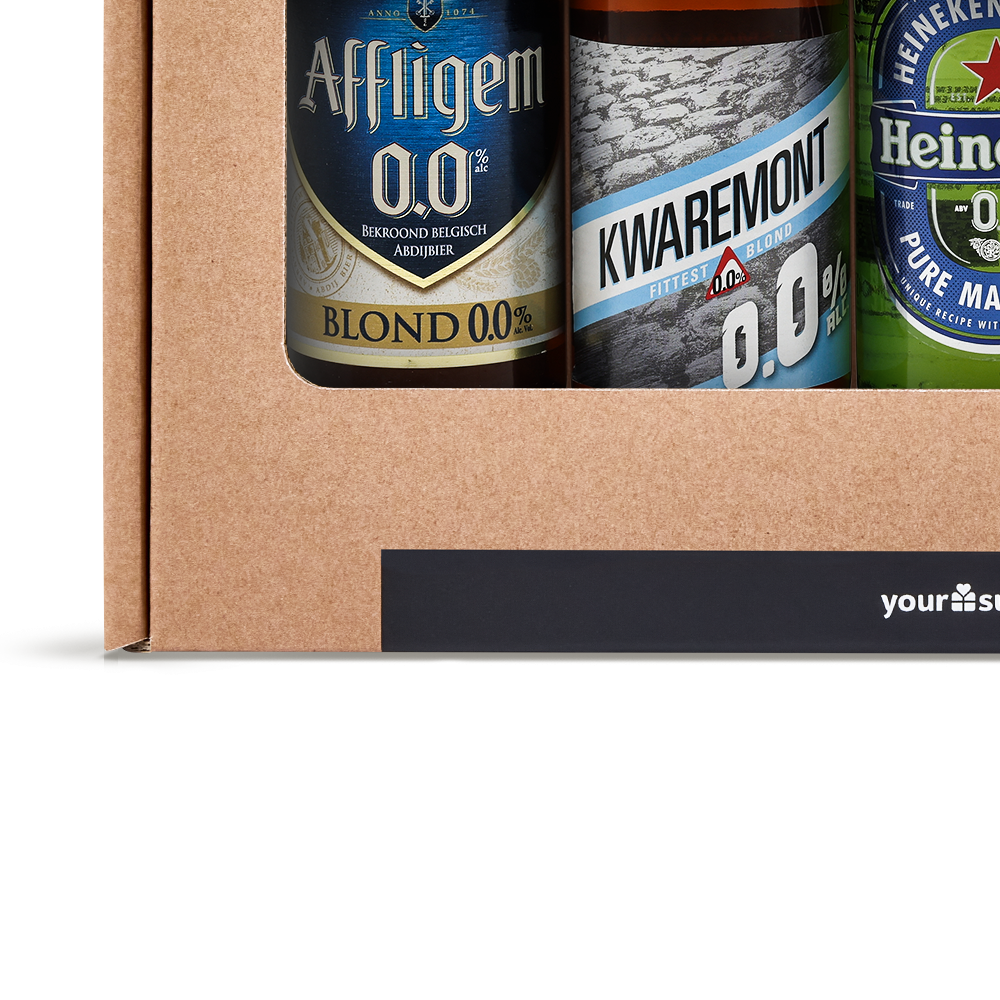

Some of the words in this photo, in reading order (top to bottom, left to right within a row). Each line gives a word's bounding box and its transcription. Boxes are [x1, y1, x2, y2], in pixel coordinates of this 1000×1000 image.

[368, 9, 401, 17] ANNO
[445, 7, 476, 16] 1074
[299, 36, 546, 136] Affligem
[950, 92, 971, 102] EST.
[474, 164, 489, 172] alc
[600, 117, 829, 289] KWAREMONT
[894, 199, 915, 210] TRADE
[954, 205, 969, 213] ABV
[431, 223, 487, 238] BELGISCH
[650, 264, 709, 299] FITTEST
[746, 222, 793, 260] BLOND
[899, 231, 953, 298] PURE
[712, 268, 747, 293] 0.0%
[899, 276, 931, 312] UNIQUE
[935, 307, 973, 328] RECIPE
[322, 304, 460, 343] BLOND
